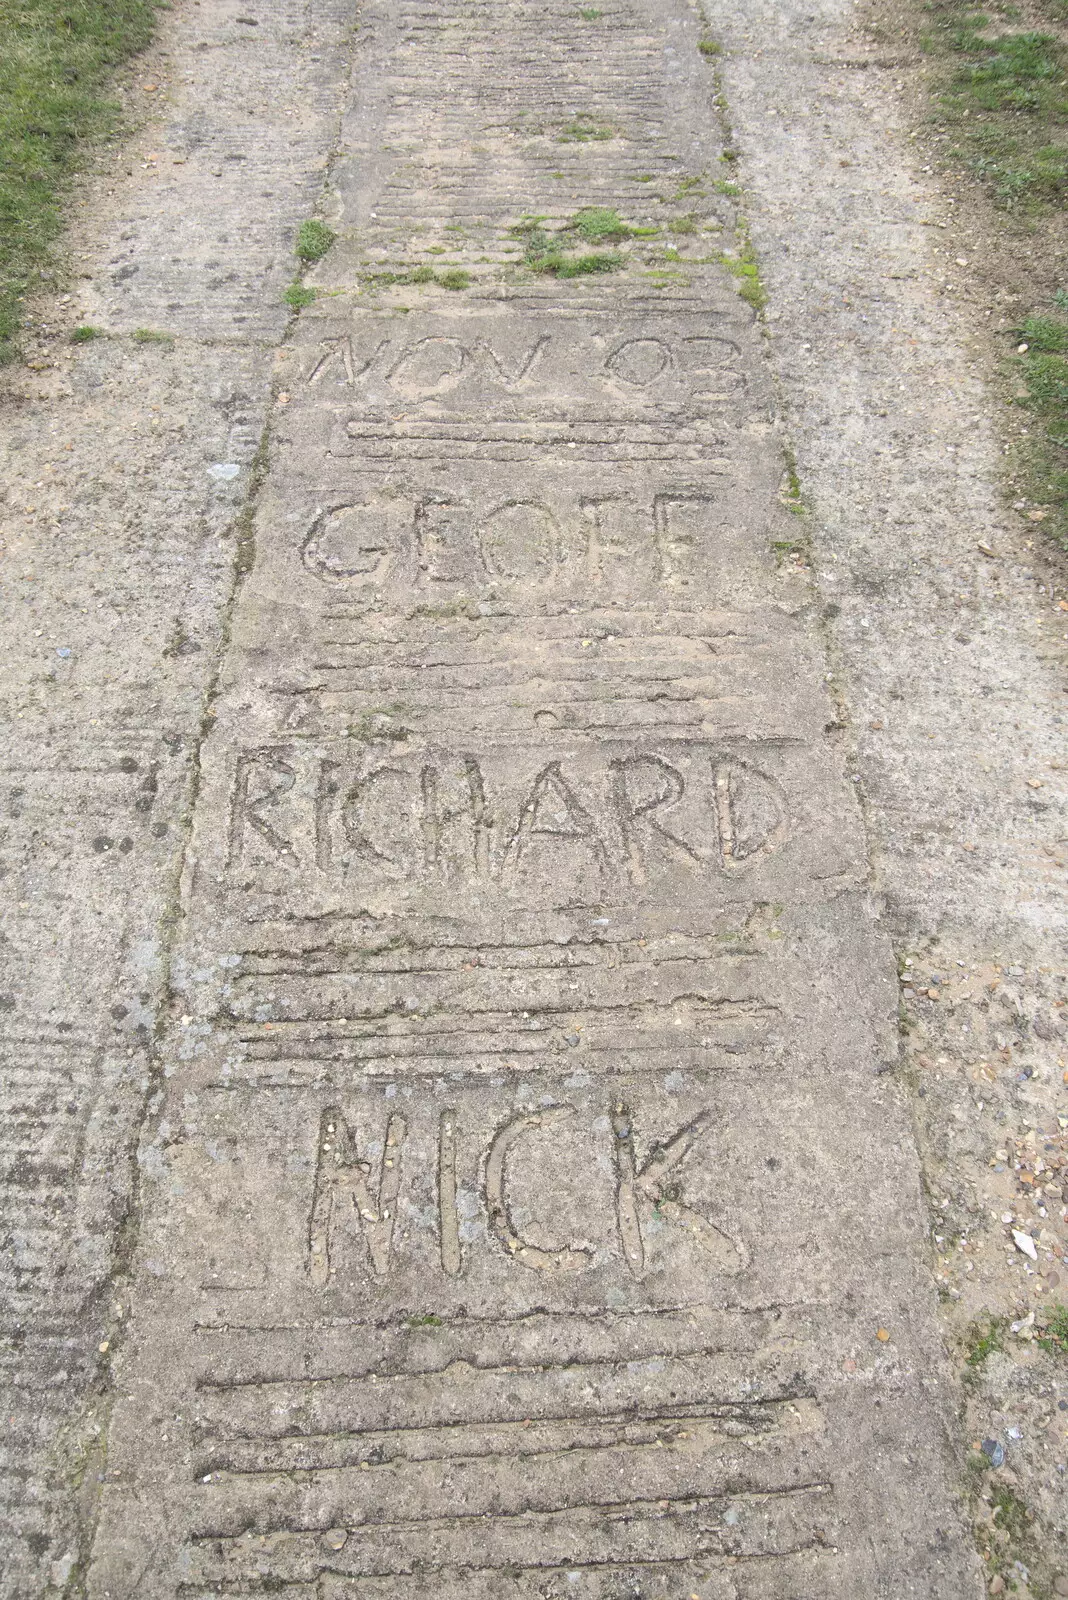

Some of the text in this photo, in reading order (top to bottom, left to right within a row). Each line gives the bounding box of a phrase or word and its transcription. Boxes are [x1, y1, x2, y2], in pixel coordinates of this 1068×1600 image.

[307, 335, 553, 394] NOV
[299, 492, 715, 586] GEOFF
[227, 748, 790, 880] RICHARD
[306, 1098, 752, 1284] NICK
